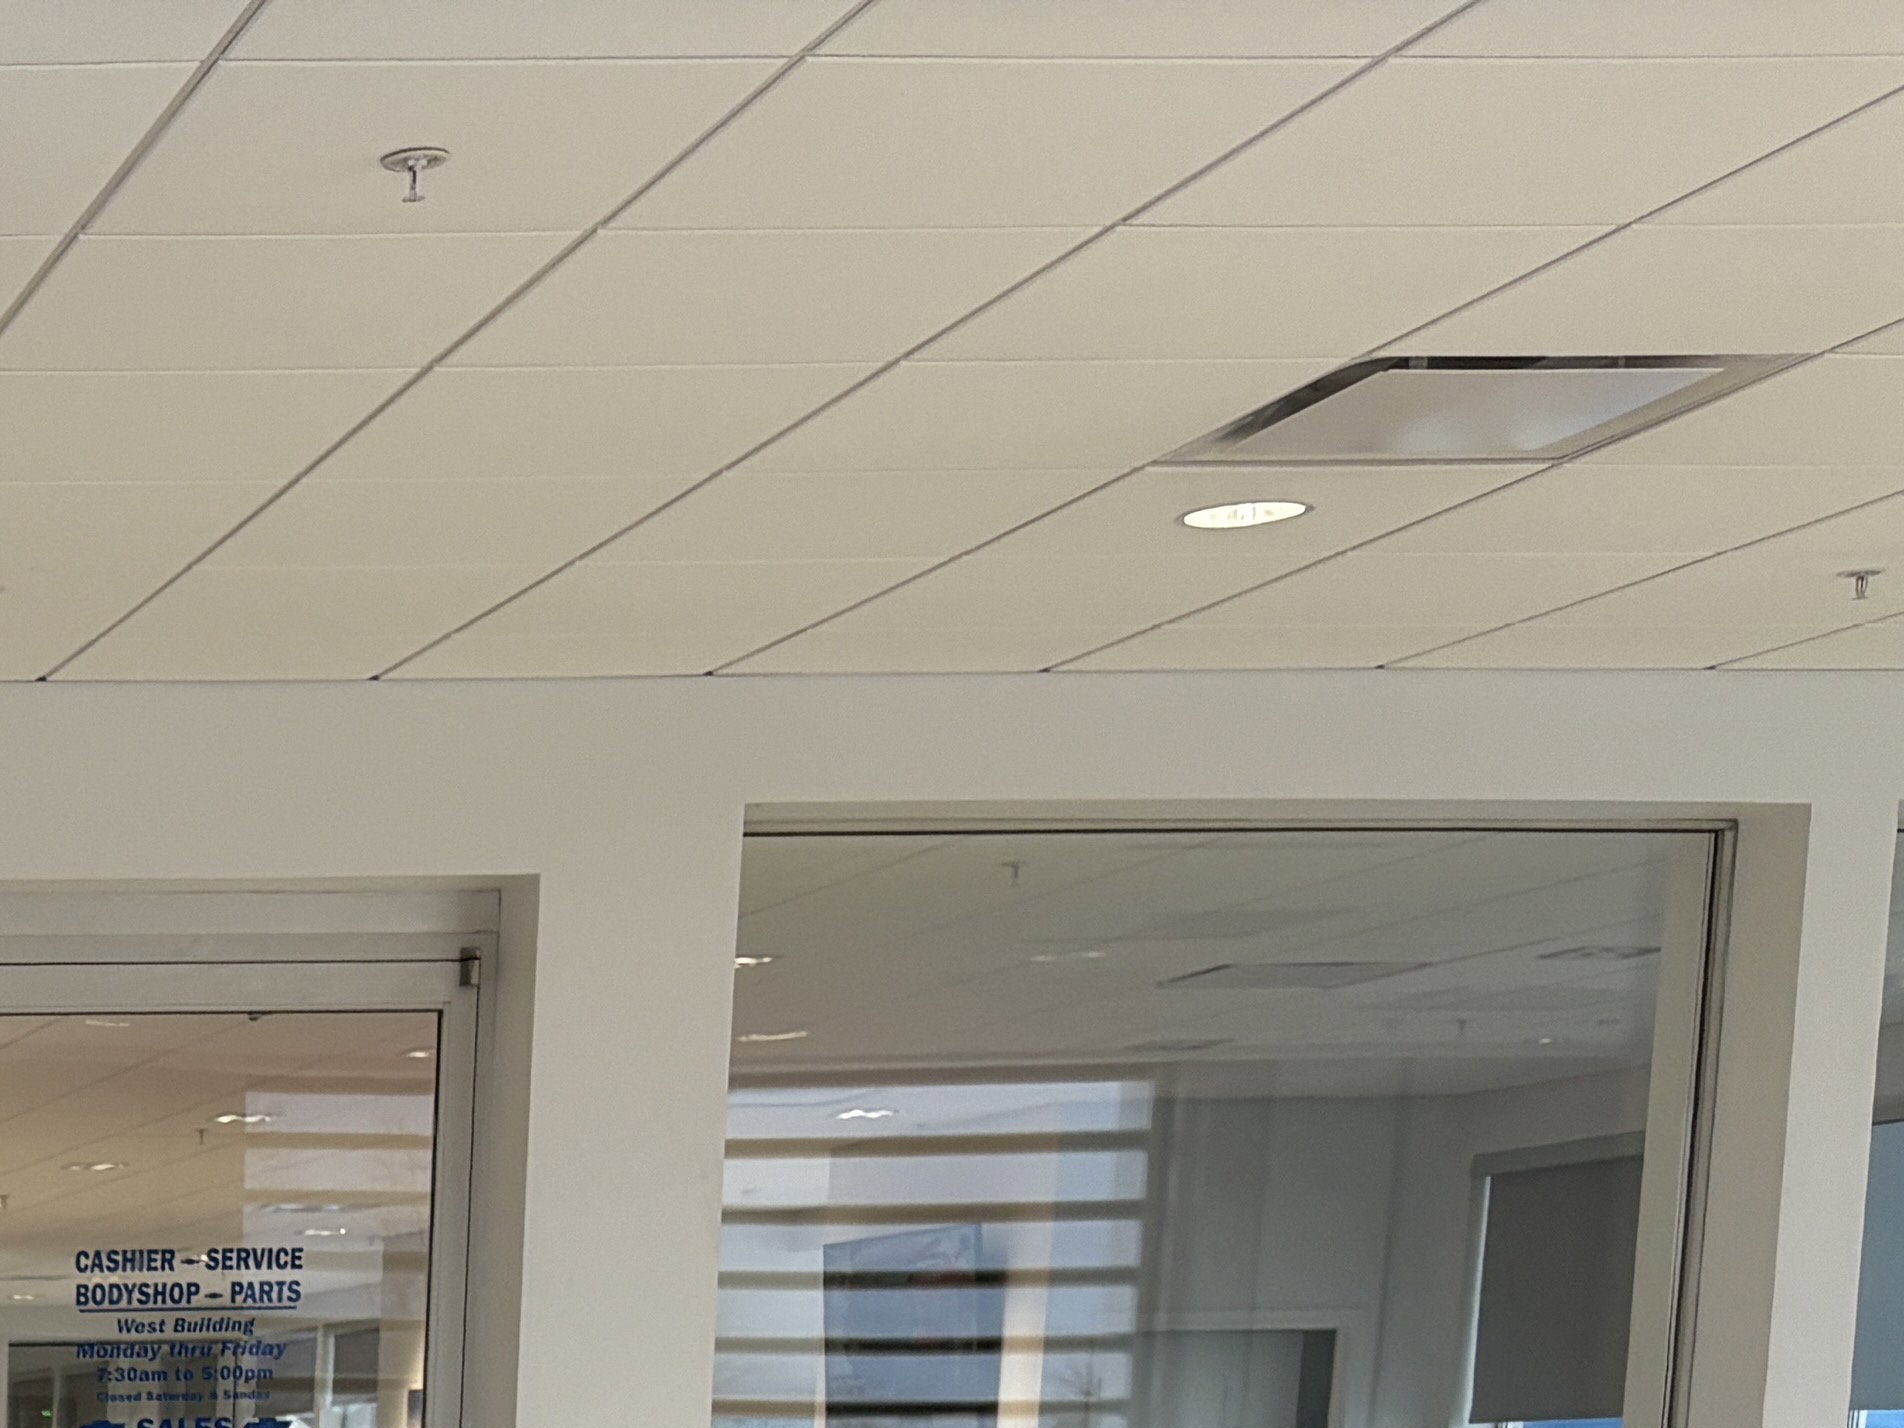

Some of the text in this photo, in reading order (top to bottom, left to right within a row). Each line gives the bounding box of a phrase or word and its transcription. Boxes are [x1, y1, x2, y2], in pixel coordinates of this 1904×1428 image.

[75, 1247, 304, 1273] CASHIER SERVICE
[75, 1280, 302, 1306] BODYSHOP PARTS
[117, 1316, 256, 1337] West Building
[76, 1340, 287, 1361] Monday thru Friday
[97, 1365, 273, 1384] 7:30am to 5:00pm
